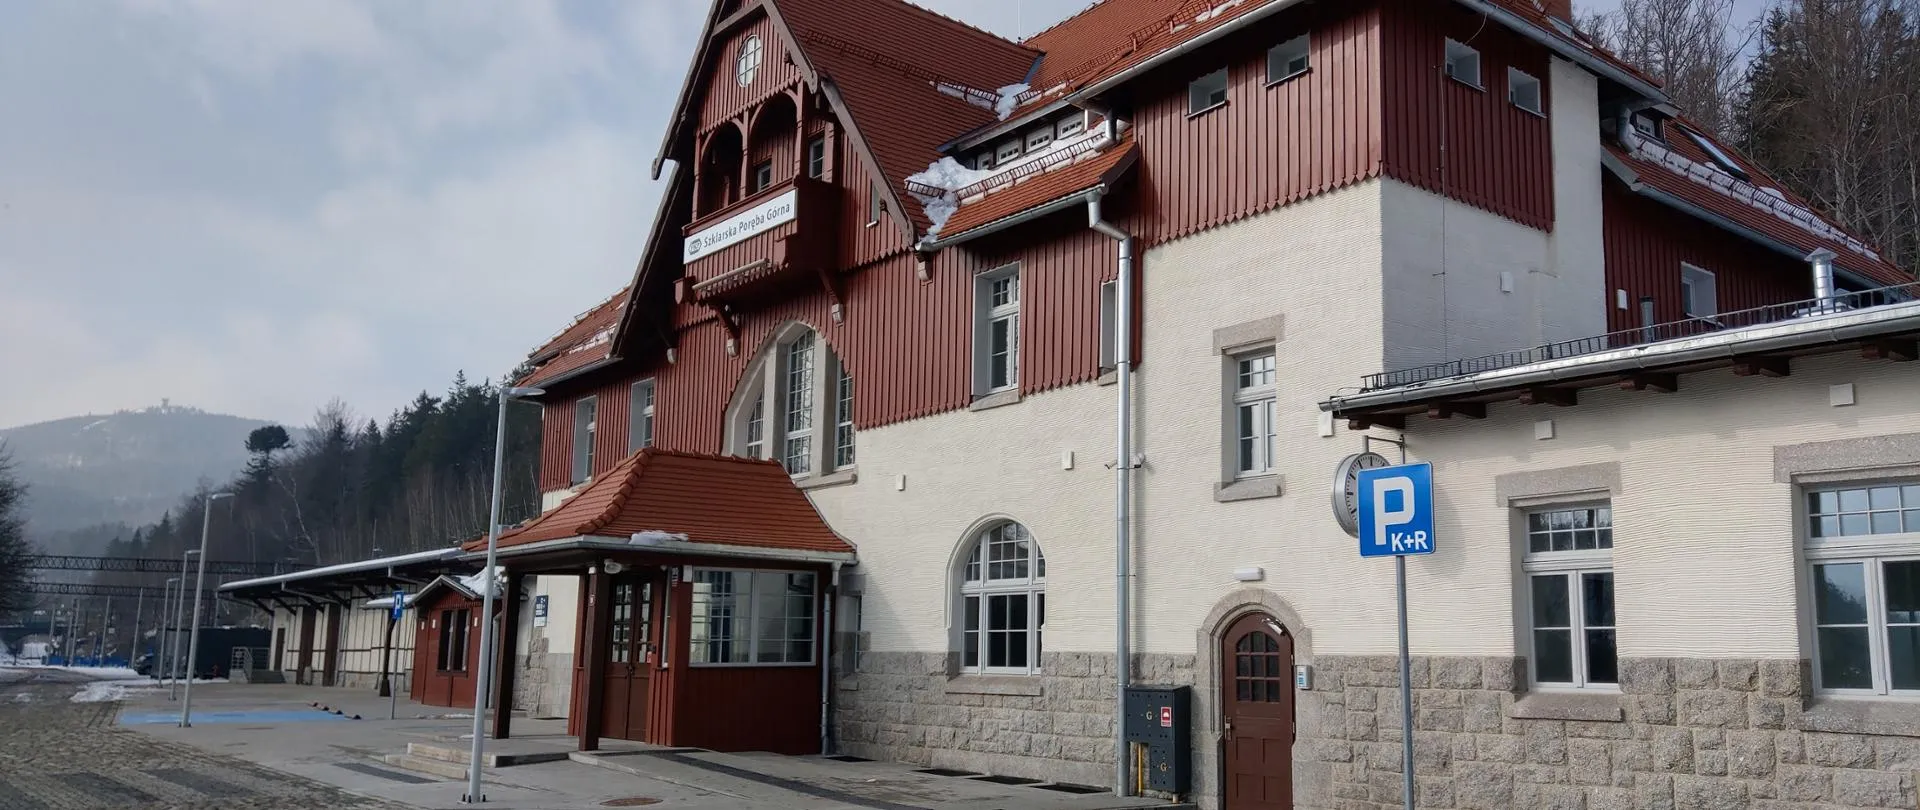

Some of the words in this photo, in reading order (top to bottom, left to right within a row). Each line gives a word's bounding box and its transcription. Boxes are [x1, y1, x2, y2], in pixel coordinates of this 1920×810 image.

[703, 226, 737, 248] Szklarska
[739, 215, 765, 233] Poręba
[766, 203, 790, 220] Górna
[1373, 476, 1415, 546] P
[1391, 530, 1428, 552] K+R
[1146, 711, 1153, 720] G
[1160, 763, 1167, 772] G
